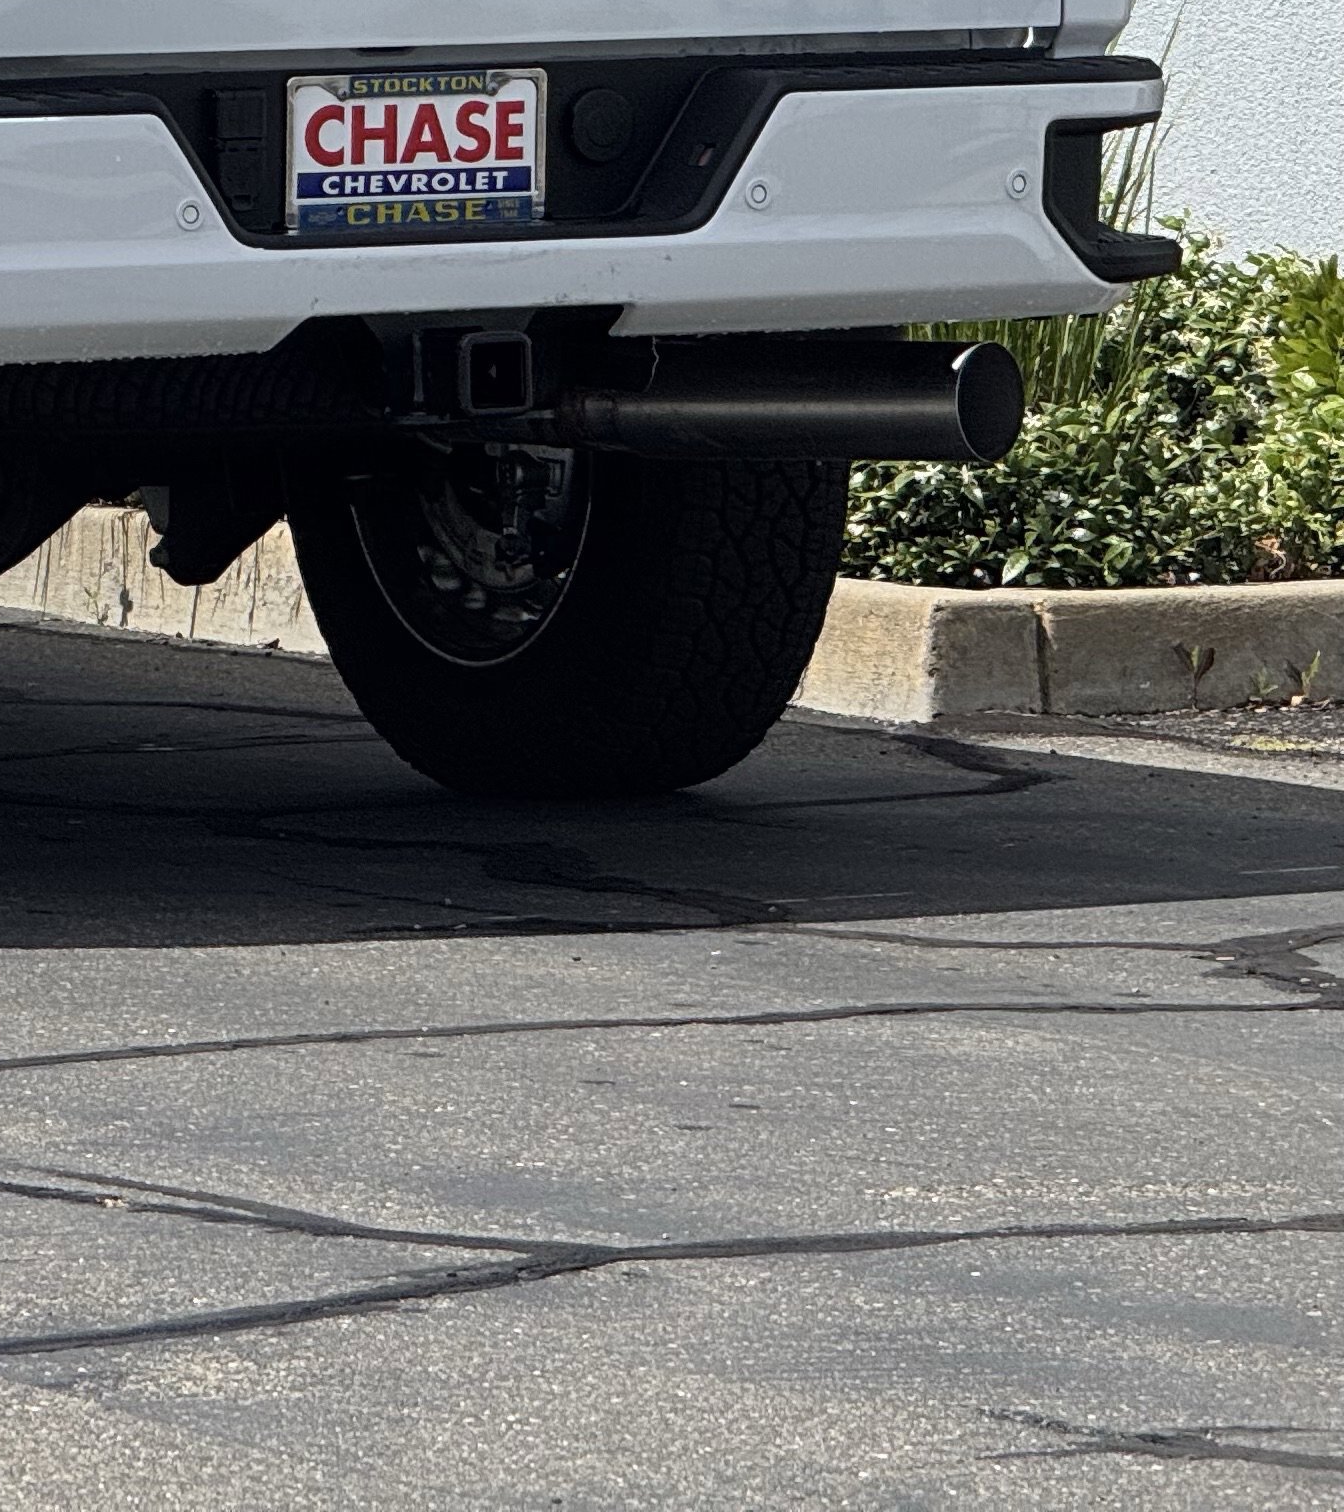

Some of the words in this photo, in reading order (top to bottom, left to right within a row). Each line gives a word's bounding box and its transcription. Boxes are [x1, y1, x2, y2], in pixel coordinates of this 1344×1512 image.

[352, 75, 486, 95] STOCKTON
[304, 100, 526, 167] CHASE
[321, 170, 509, 195] CHEVROLET
[347, 199, 487, 225] CHASE
